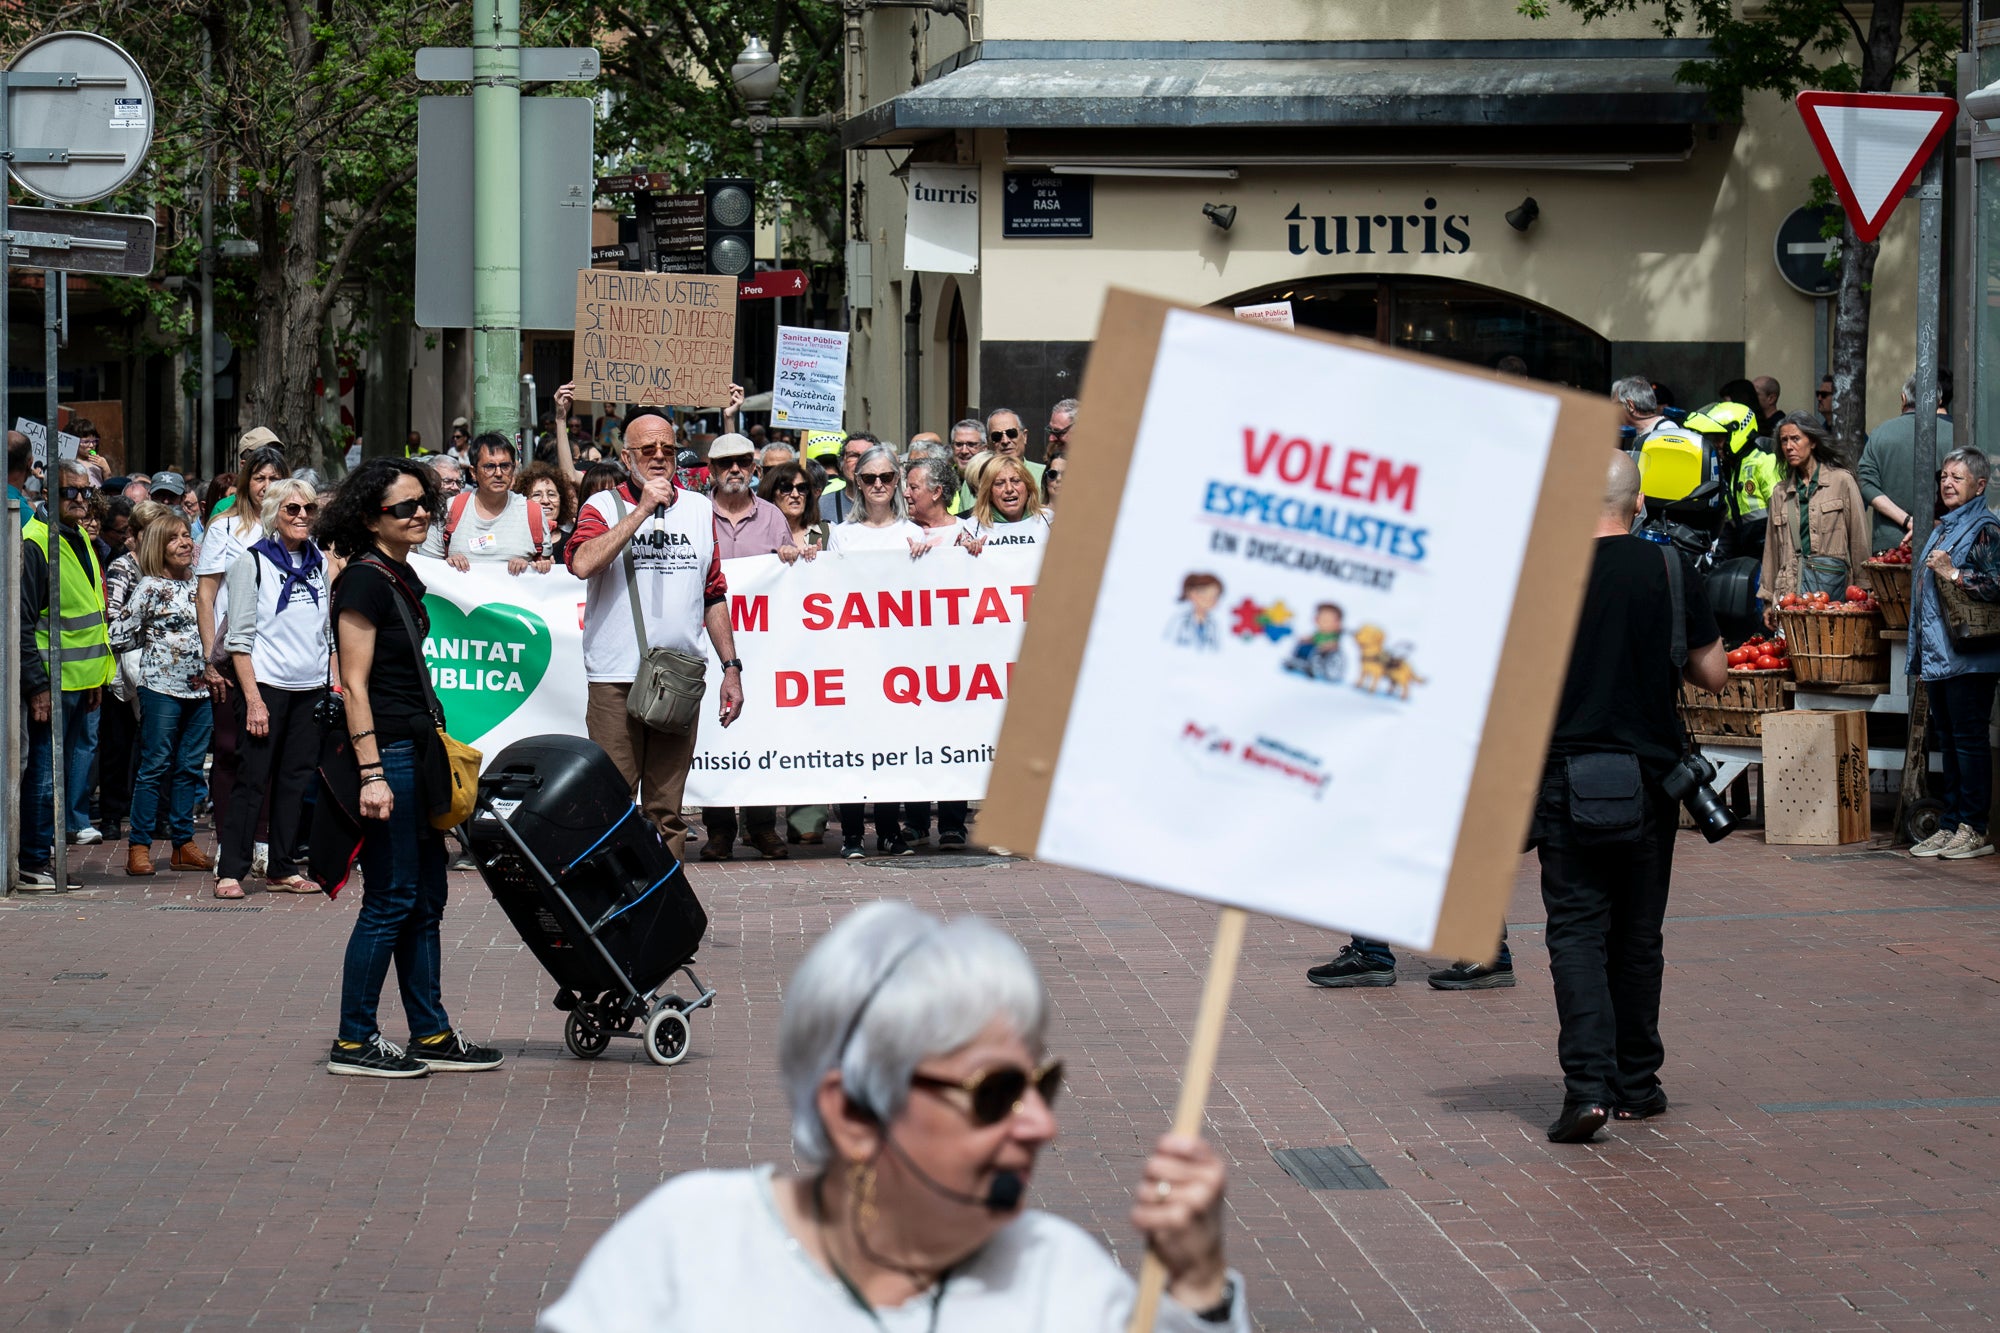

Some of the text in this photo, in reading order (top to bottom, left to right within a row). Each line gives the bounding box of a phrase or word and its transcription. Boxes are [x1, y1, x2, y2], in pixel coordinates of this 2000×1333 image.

[914, 181, 977, 204] turris
[1031, 178, 1063, 187] CARRER
[1037, 189, 1057, 197] DE LA
[674, 199, 699, 207] Montserrat
[1033, 200, 1061, 210] RASA
[683, 215, 704, 224] Independ
[1284, 197, 1471, 256] turris
[600, 249, 625, 259] Freixa
[584, 273, 720, 308] MIENTRAS USTEDES
[744, 286, 763, 294] Pere
[585, 303, 605, 330] SE
[609, 305, 661, 335] NUTREN
[673, 308, 734, 340] IMPUESTOS
[1240, 309, 1288, 319] Sanitat Pública
[583, 332, 607, 359] CON
[609, 335, 650, 363] DIETAS
[654, 339, 664, 361] Y
[782, 333, 842, 346] Sanitat Pública
[584, 359, 605, 381] AL
[607, 361, 646, 386] RESTO
[650, 365, 672, 390] NOS
[780, 370, 806, 381] 25%
[781, 358, 818, 370] Urgent!
[591, 382, 712, 406] EN EL ABISMO
[780, 387, 836, 402] l'Assistència
[792, 401, 835, 412] Primària
[1242, 427, 1420, 514] VOLEM
[1202, 480, 1430, 562] ESPECIALISTES
[988, 535, 1036, 546] MAREA
[1209, 528, 1398, 593] EN DISCAPACITAT
[801, 585, 1038, 632] SANITAT
[421, 637, 526, 663] ANITAT
[426, 662, 525, 693] ÚBLICA
[775, 662, 1017, 708] DE QUA
[758, 749, 865, 770] d'entitats
[872, 752, 908, 771] per
[915, 745, 932, 765] la
[940, 743, 995, 765] Sanit
